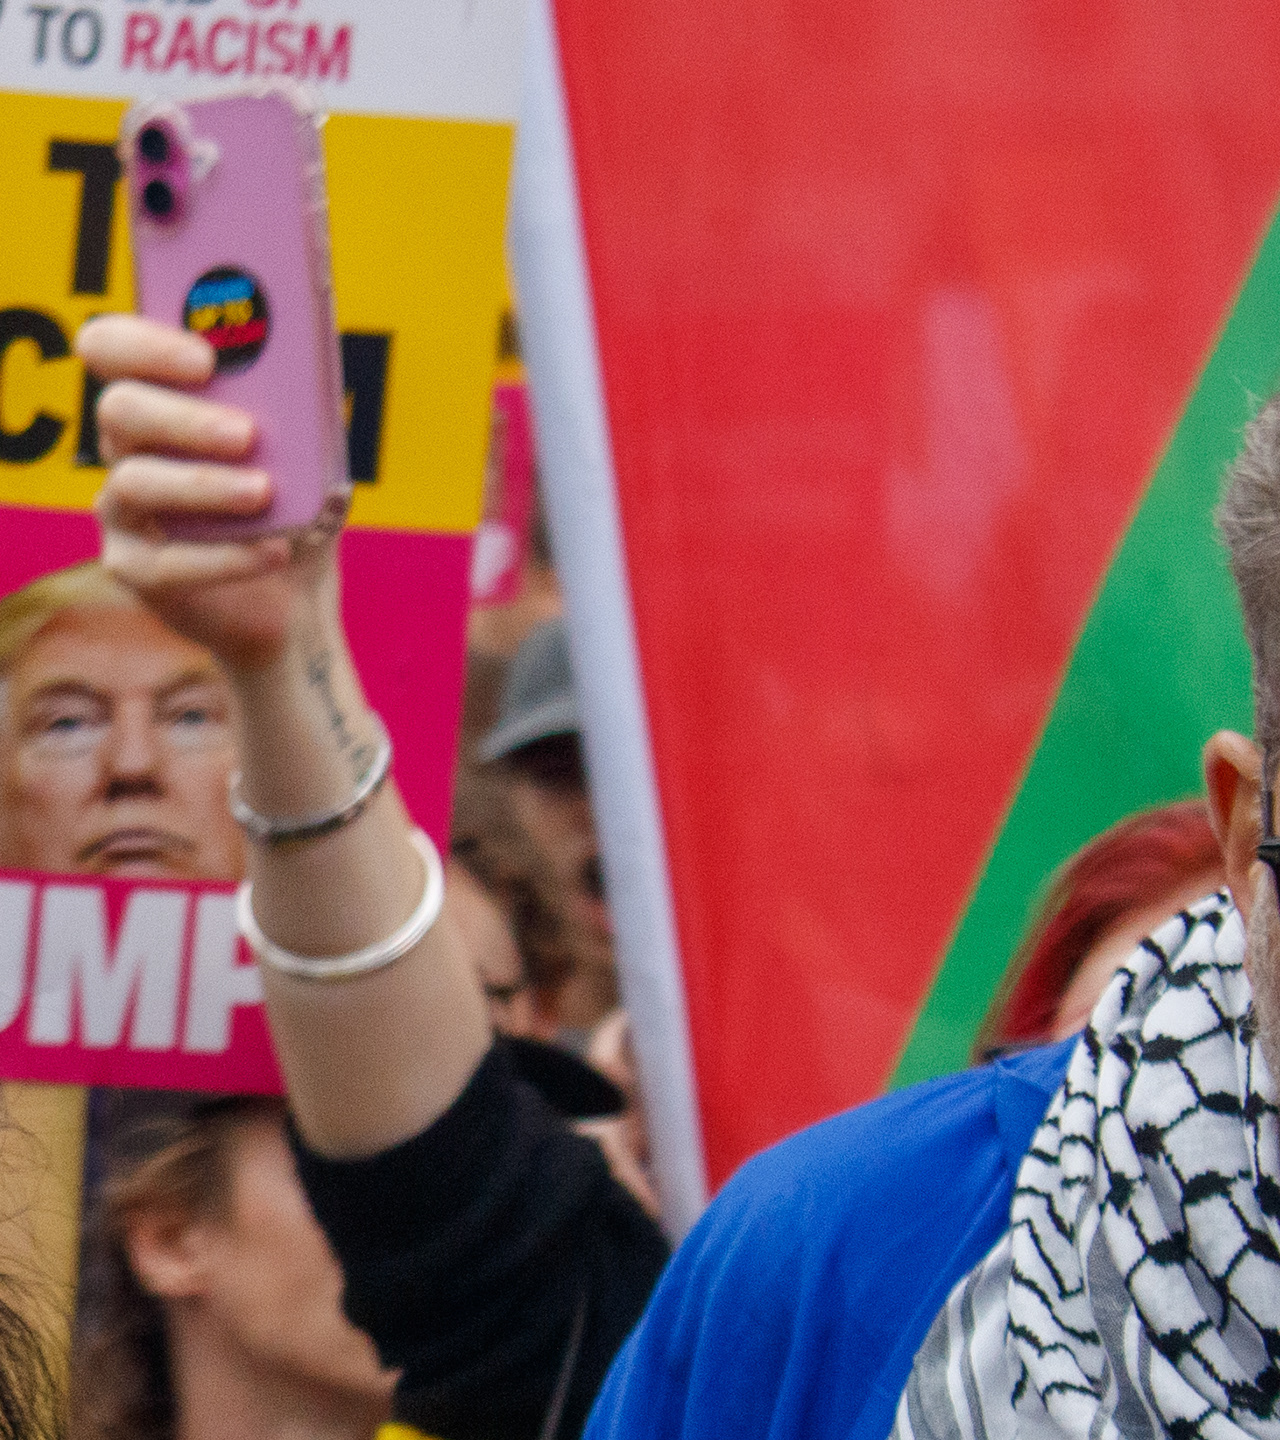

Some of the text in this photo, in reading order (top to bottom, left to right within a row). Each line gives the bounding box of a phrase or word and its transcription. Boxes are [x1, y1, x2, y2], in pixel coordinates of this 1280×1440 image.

[26, 5, 351, 81] TO RACISM
[46, 137, 124, 297] T
